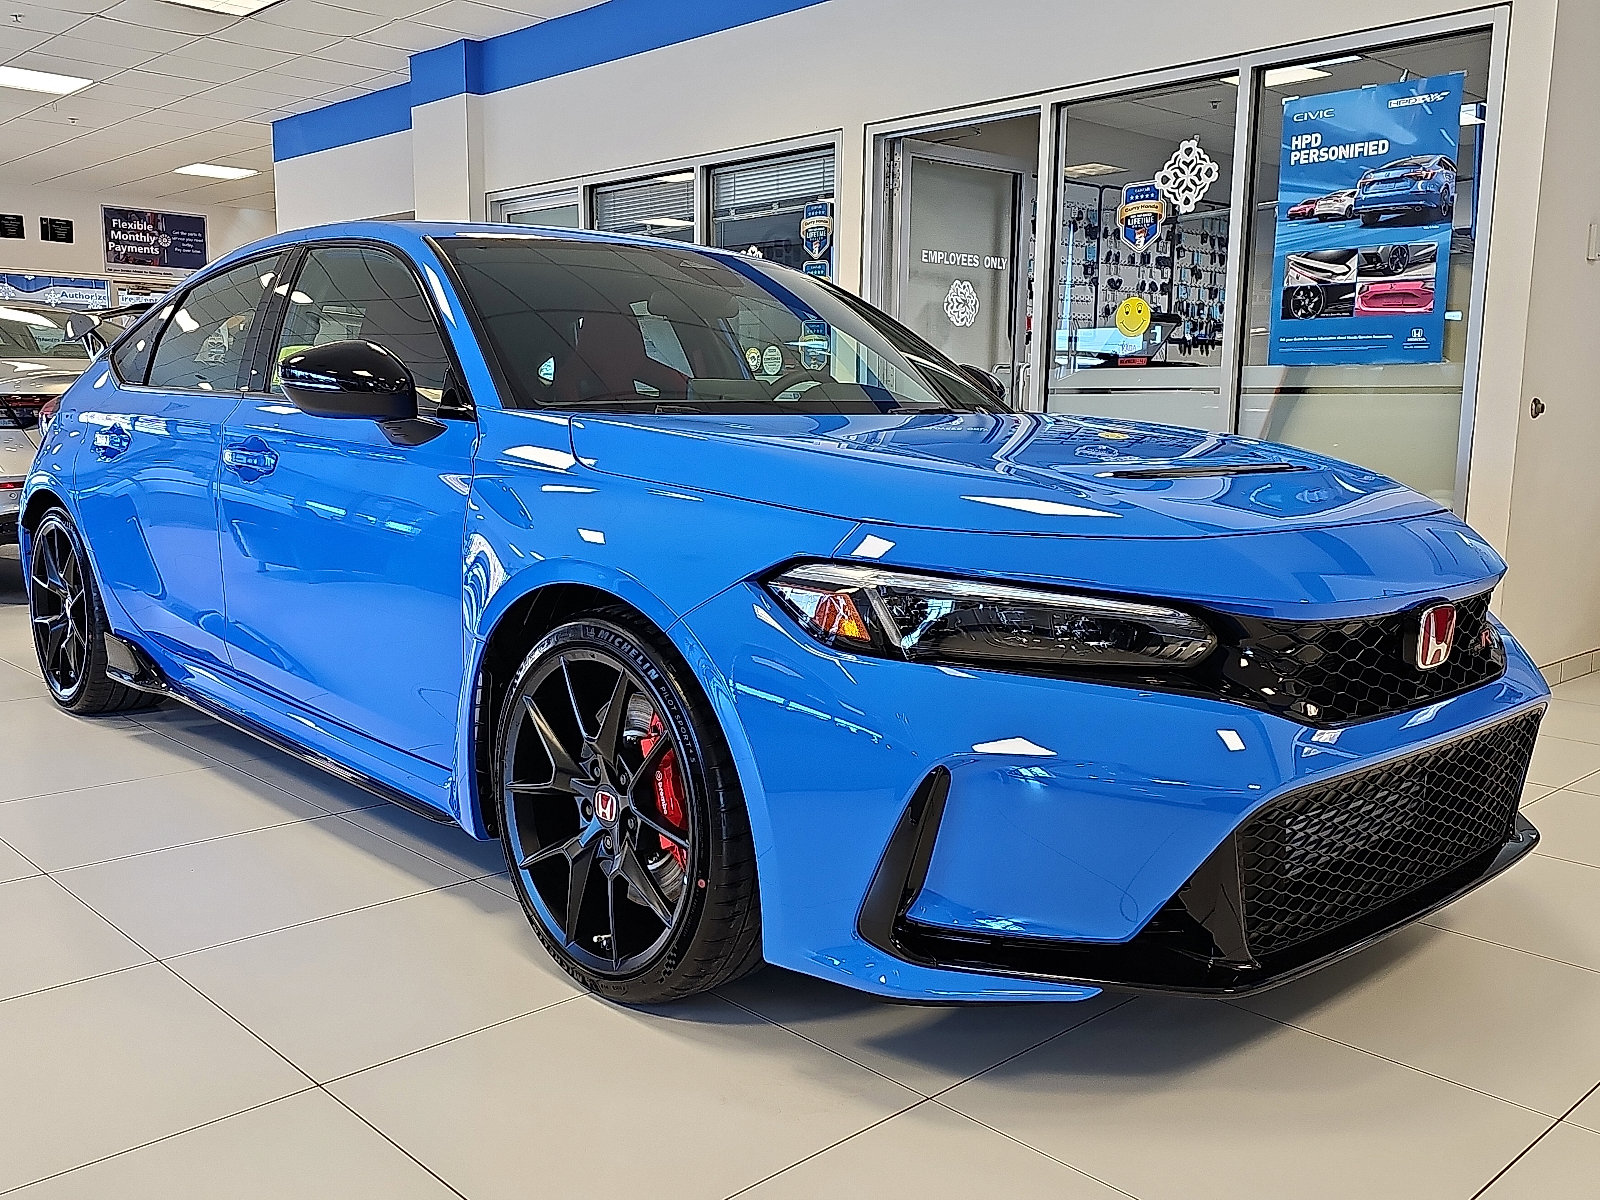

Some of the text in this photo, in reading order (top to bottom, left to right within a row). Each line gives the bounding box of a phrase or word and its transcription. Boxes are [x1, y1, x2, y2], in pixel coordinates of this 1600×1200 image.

[1293, 108, 1335, 122] CIVIC
[1291, 133, 1322, 150] HPD
[1290, 139, 1390, 166] PERSONIFIED
[112, 219, 153, 231] Flexible
[110, 230, 156, 245] Monthly
[108, 241, 160, 255] Payments
[921, 249, 1007, 270] EMPLOYEES ONLY
[598, 629, 660, 681] MICHELIN
[660, 686, 677, 711] PILOT
[675, 714, 692, 747] SPORT
[657, 781, 668, 815] brembo
